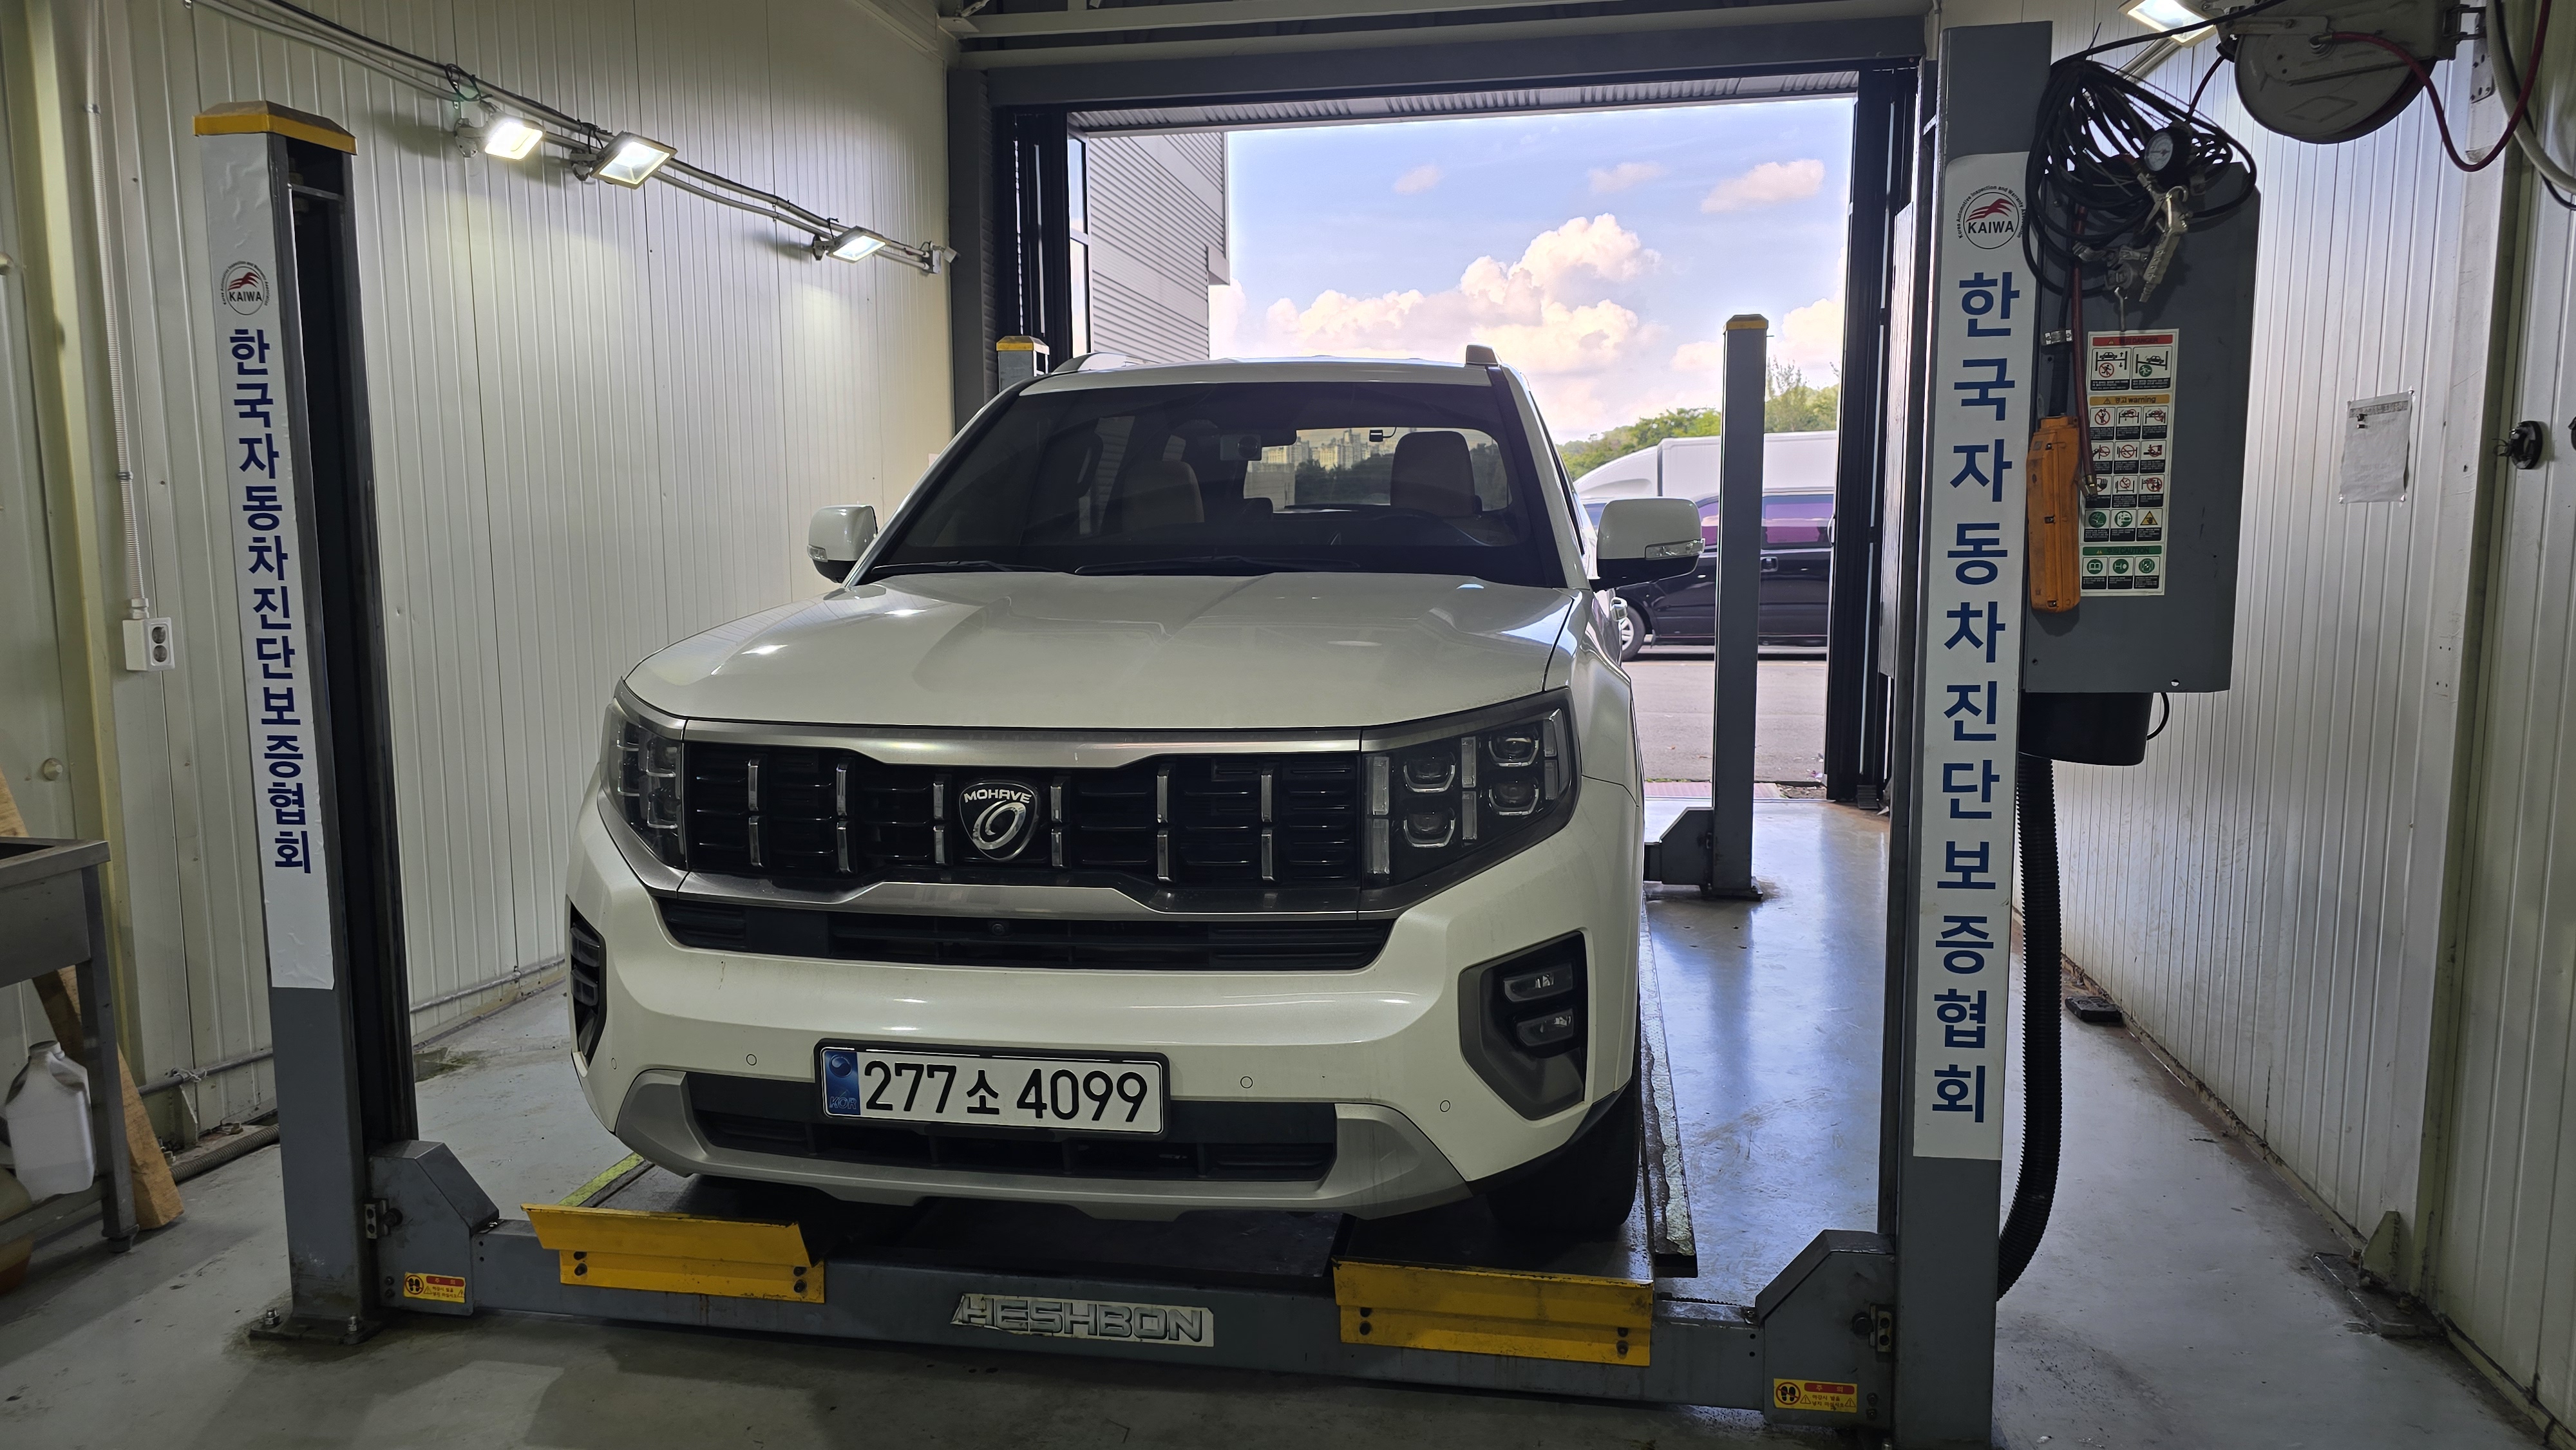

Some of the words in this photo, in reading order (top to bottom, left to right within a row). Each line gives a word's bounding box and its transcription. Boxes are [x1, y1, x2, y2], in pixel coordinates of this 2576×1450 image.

[1956, 196, 1971, 222] Automotive
[1971, 185, 1997, 196] Inspection
[2008, 189, 2023, 207] Warranty
[1968, 221, 2014, 234] KAIWA
[229, 291, 263, 302] KAIWA
[229, 328, 311, 874] 한국자동차진단보증협회
[1932, 271, 2020, 1123] 한국자동차진단보증협회
[963, 789, 1032, 804] MOHAVE
[829, 1096, 857, 1109] KOR
[1016, 1068, 1148, 1123] 4099
[960, 1295, 1203, 1342] HESHBON
